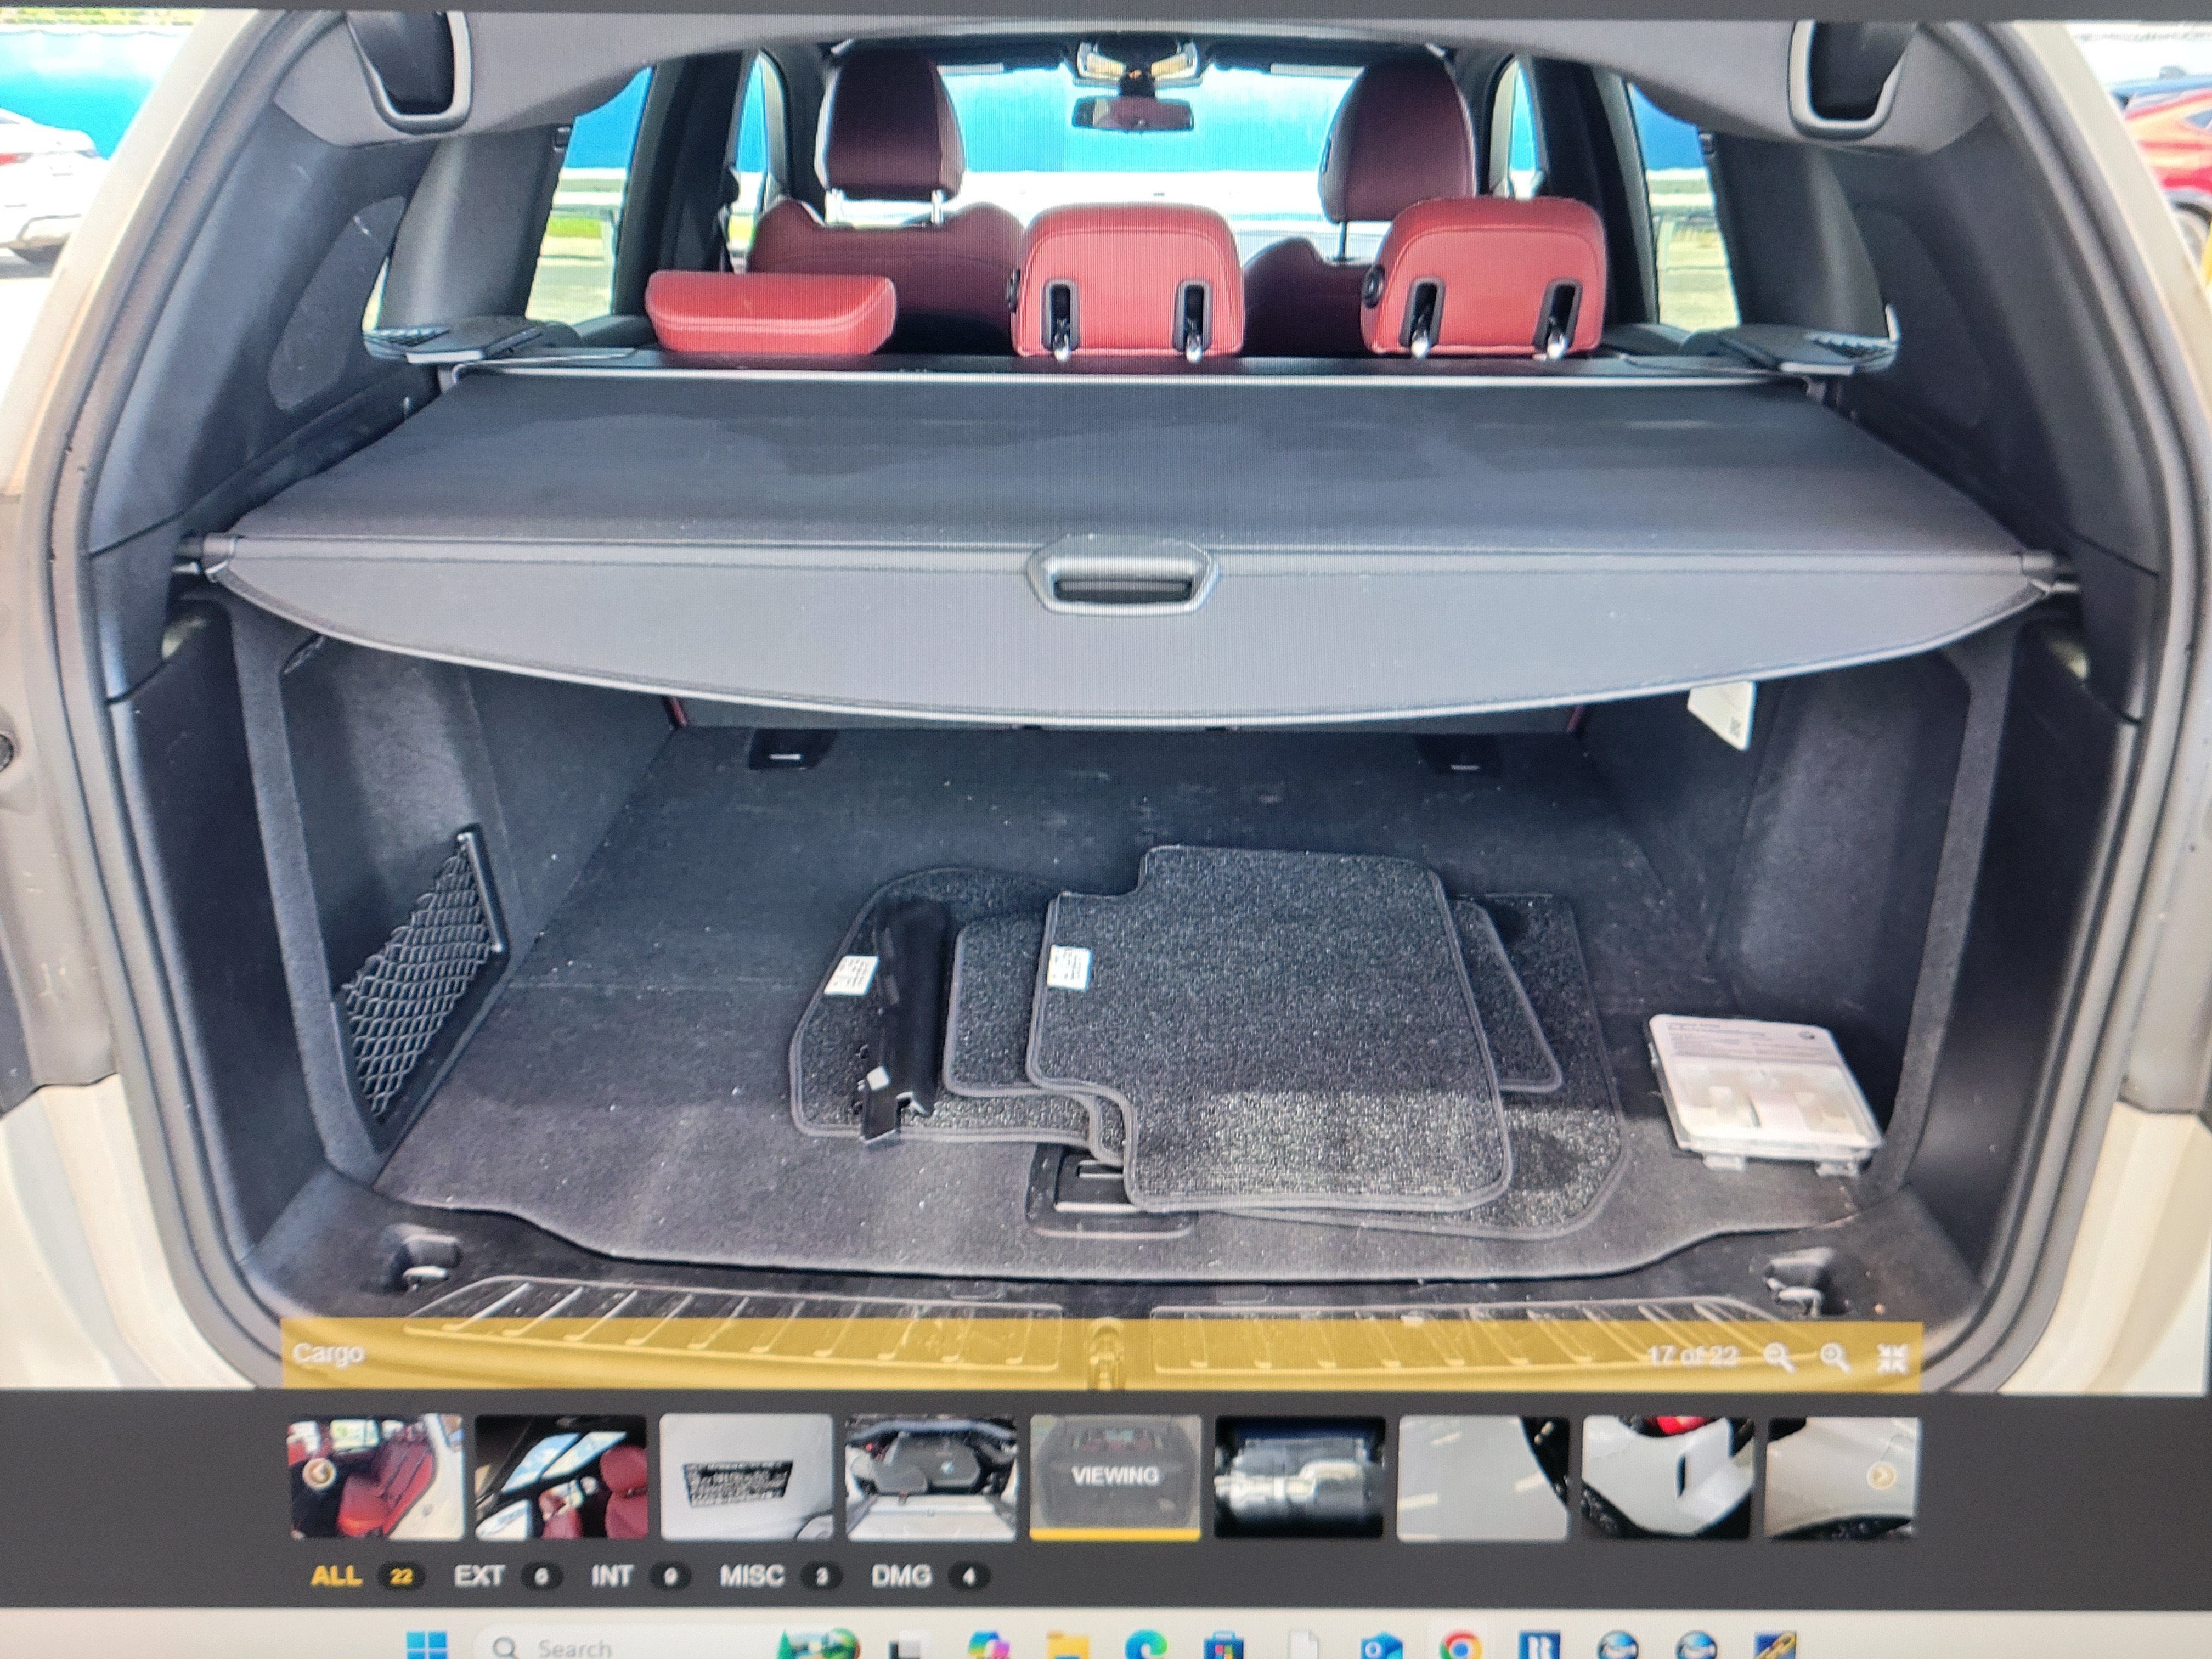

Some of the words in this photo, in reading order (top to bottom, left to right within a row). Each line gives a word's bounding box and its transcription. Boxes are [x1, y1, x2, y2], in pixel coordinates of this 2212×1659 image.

[292, 1343, 366, 1369] Cargo
[1647, 1345, 1676, 1367] 17
[1680, 1345, 1706, 1367] of
[1709, 1345, 1741, 1367] 22
[1071, 1466, 1160, 1485] VIEWING
[311, 1565, 363, 1587] ALL
[390, 1568, 413, 1585] 22
[454, 1564, 505, 1587] EXT
[592, 1564, 634, 1587] INT
[720, 1564, 785, 1588] MISC
[816, 1567, 829, 1585] 3
[872, 1564, 932, 1588] DMG
[963, 1567, 975, 1585] 4
[539, 1639, 612, 1658] Search
